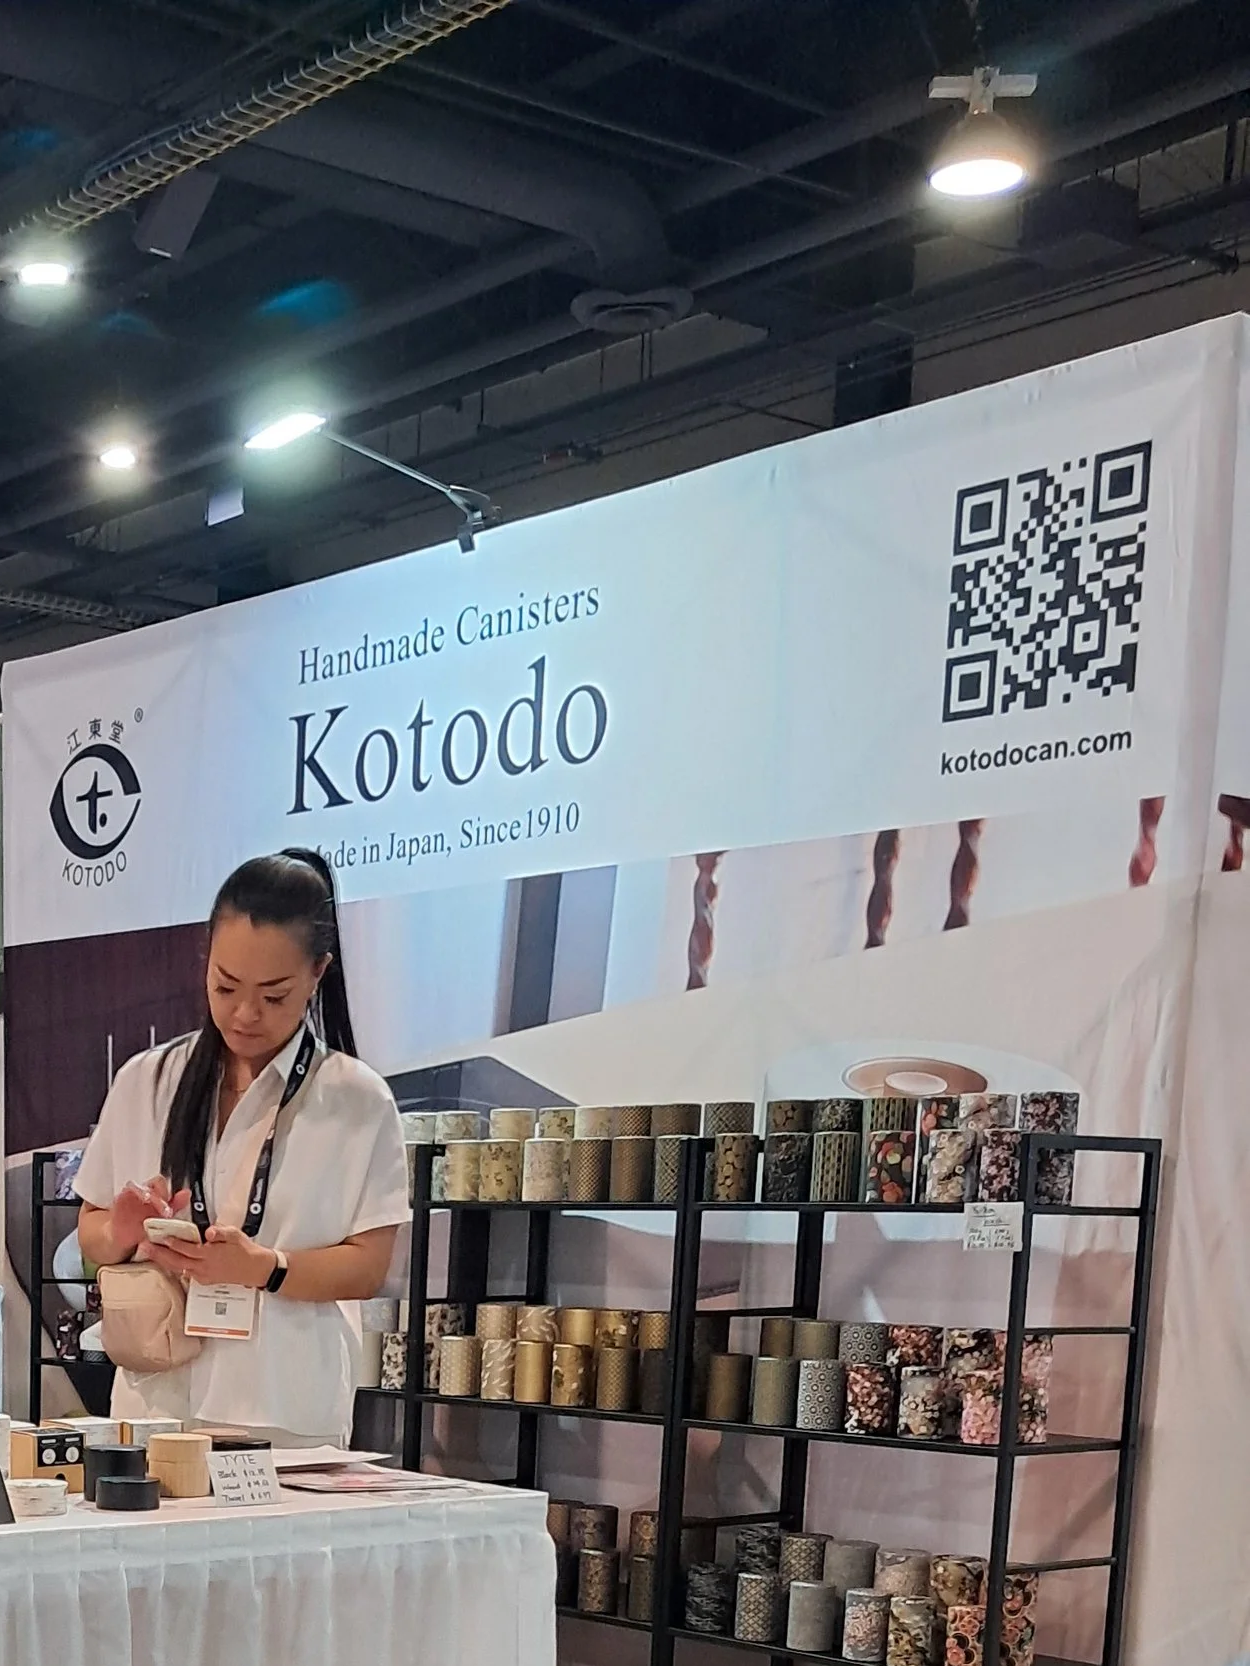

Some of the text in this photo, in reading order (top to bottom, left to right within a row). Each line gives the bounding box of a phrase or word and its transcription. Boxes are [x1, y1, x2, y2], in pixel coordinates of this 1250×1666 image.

[299, 586, 600, 685] Handmade Canisters
[286, 655, 607, 815] Kotodo
[940, 730, 1133, 776] kotodocan.com
[62, 850, 127, 888] KOTODO
[316, 840, 356, 870] ade
[362, 836, 381, 864] in
[386, 831, 452, 866] Japan,
[219, 1453, 256, 1466] TYTE
